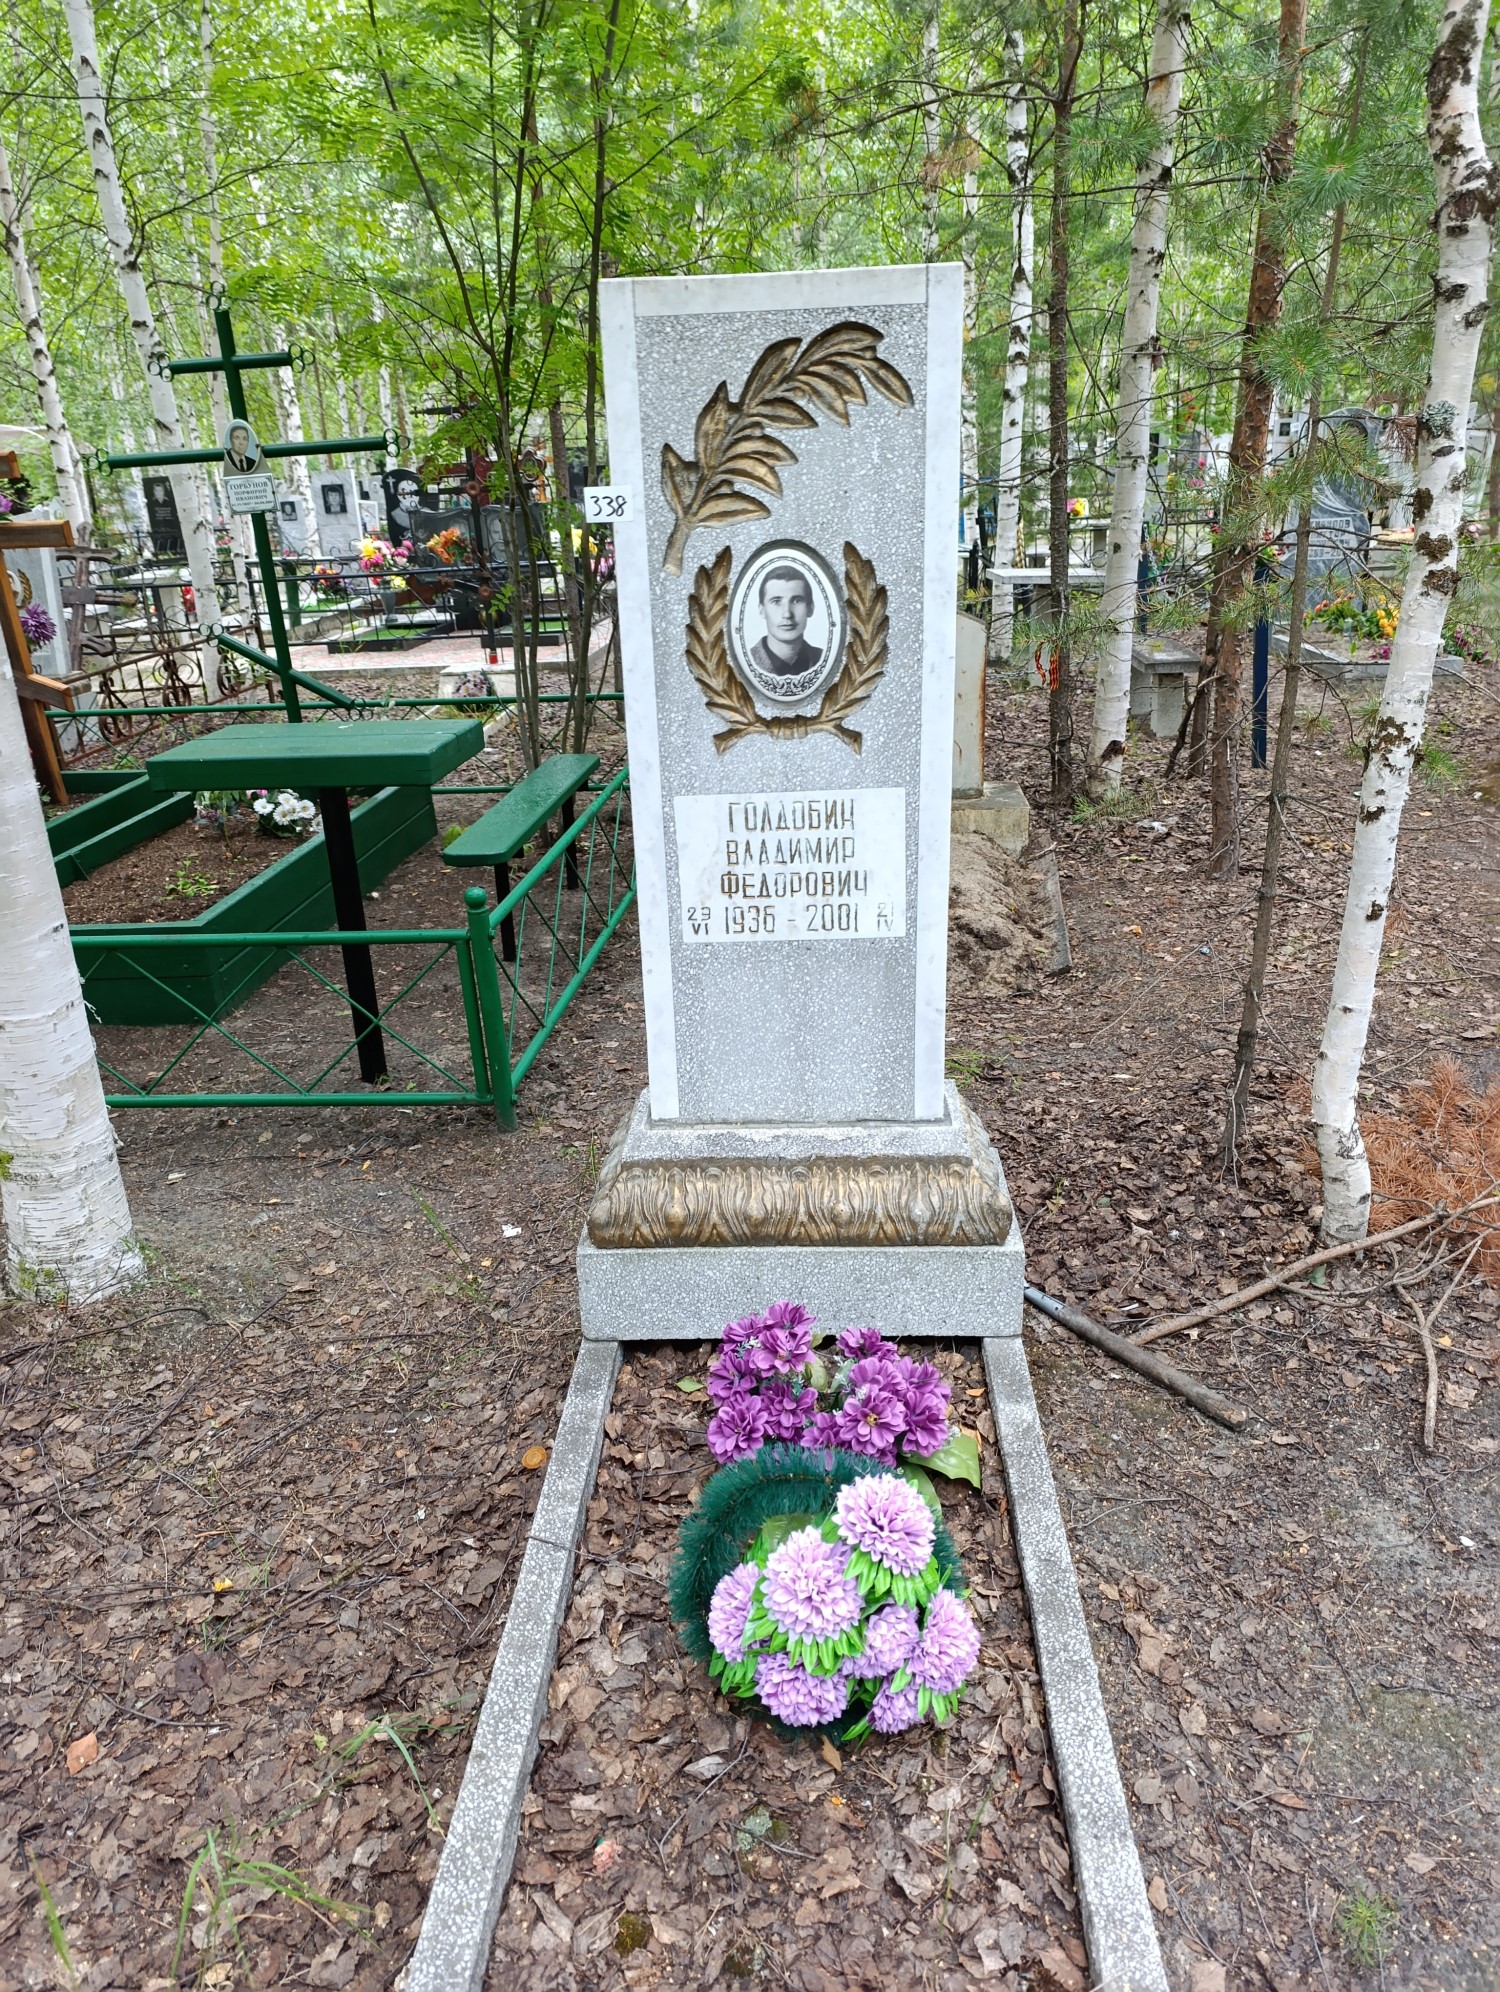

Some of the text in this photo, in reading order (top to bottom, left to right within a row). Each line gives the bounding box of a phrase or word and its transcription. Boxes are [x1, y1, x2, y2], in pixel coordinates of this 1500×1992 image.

[590, 495, 627, 517] 338
[728, 799, 855, 833] ГОЛДОБИН
[726, 837, 855, 865] ВЛАДИМИР
[721, 870, 867, 899] ФЕДОРОВИЧ
[687, 906, 711, 921] 23
[725, 905, 776, 934] 1936
[806, 903, 858, 933] 2001
[876, 901, 894, 918] 21
[691, 923, 709, 935] VI
[877, 919, 894, 932] IV
